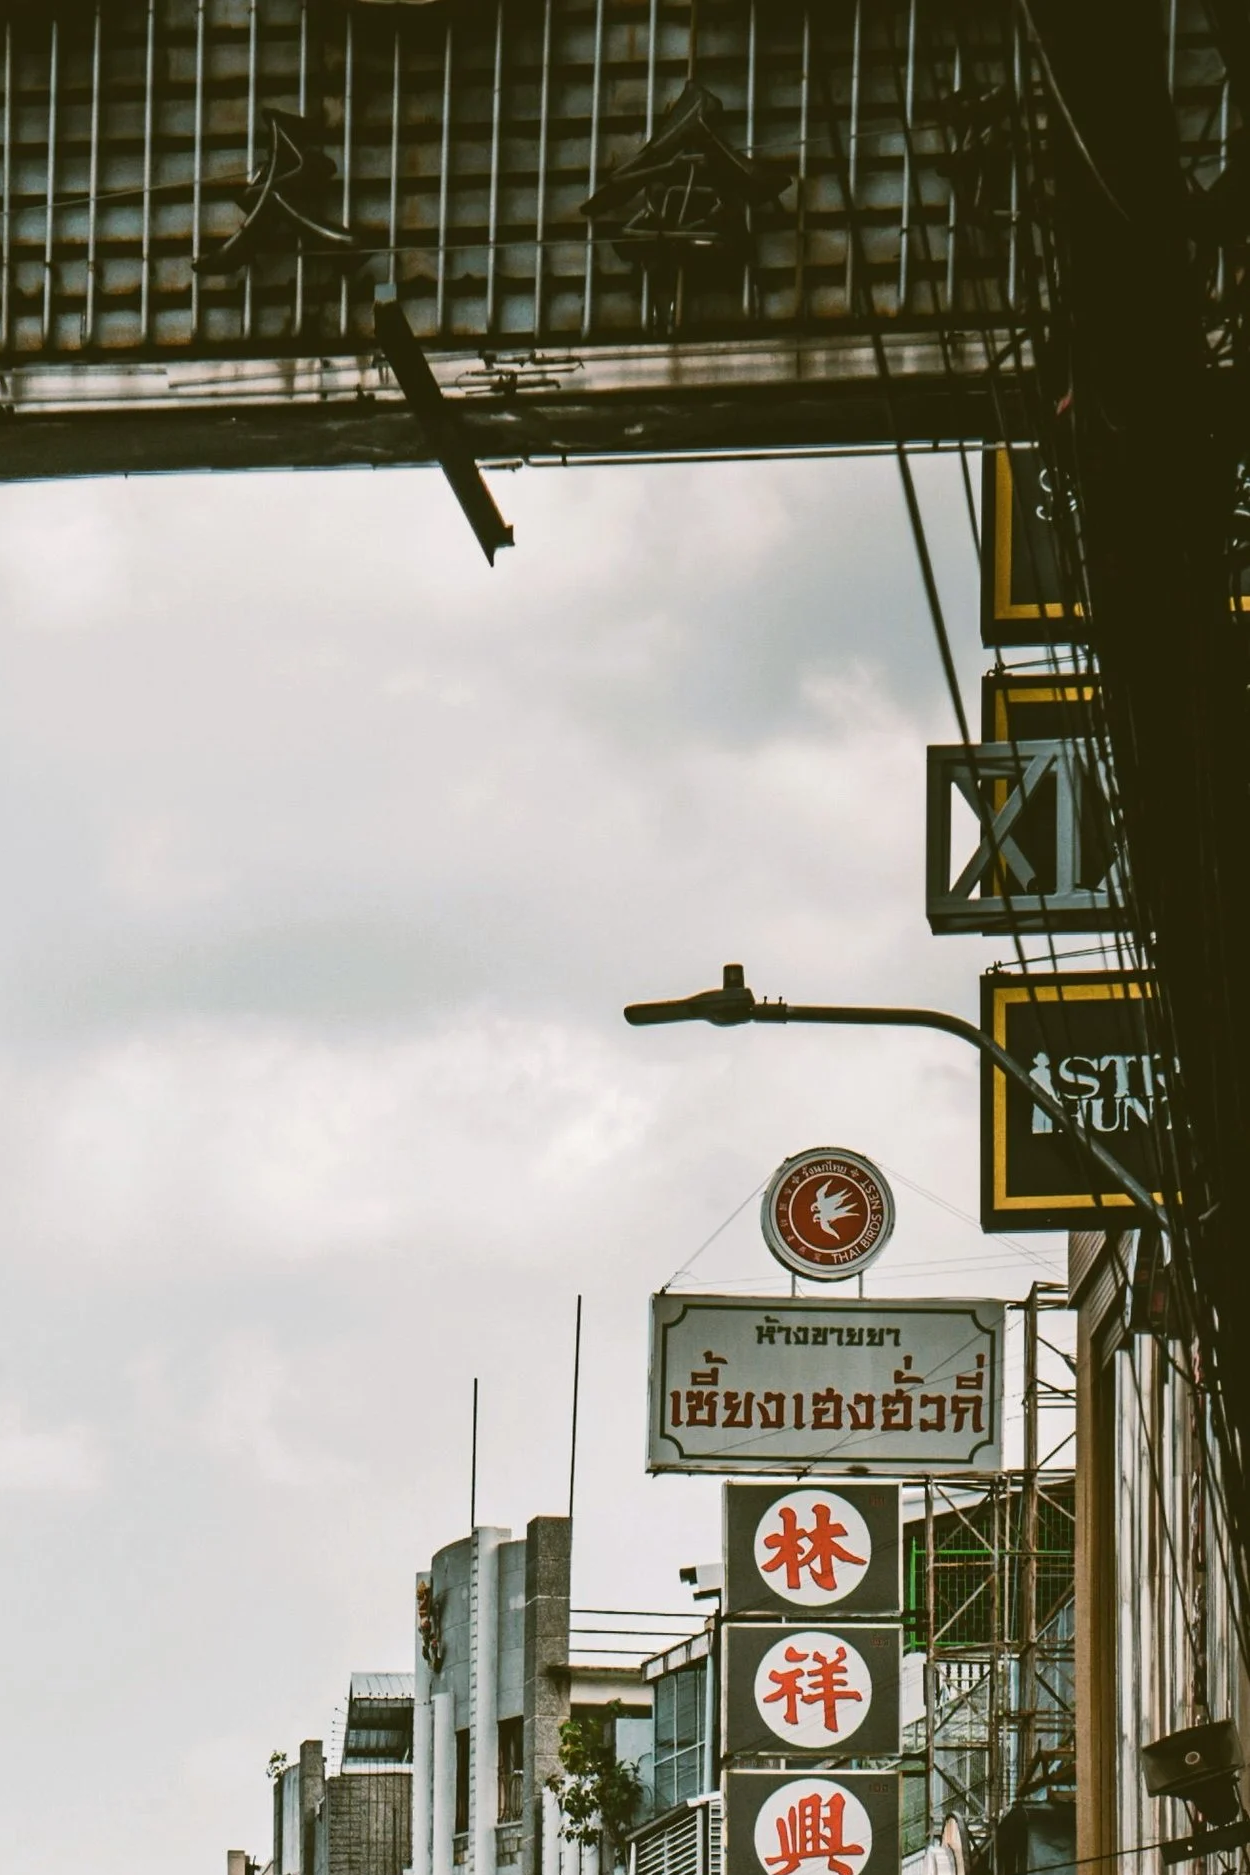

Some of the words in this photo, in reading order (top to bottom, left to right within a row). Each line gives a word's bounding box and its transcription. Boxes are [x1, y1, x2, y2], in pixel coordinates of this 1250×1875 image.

[860, 1179, 882, 1210] NEST
[860, 1213, 882, 1249] BIRDS
[831, 1246, 861, 1264] THAI
[755, 1316, 901, 1348] ห้างขายยา
